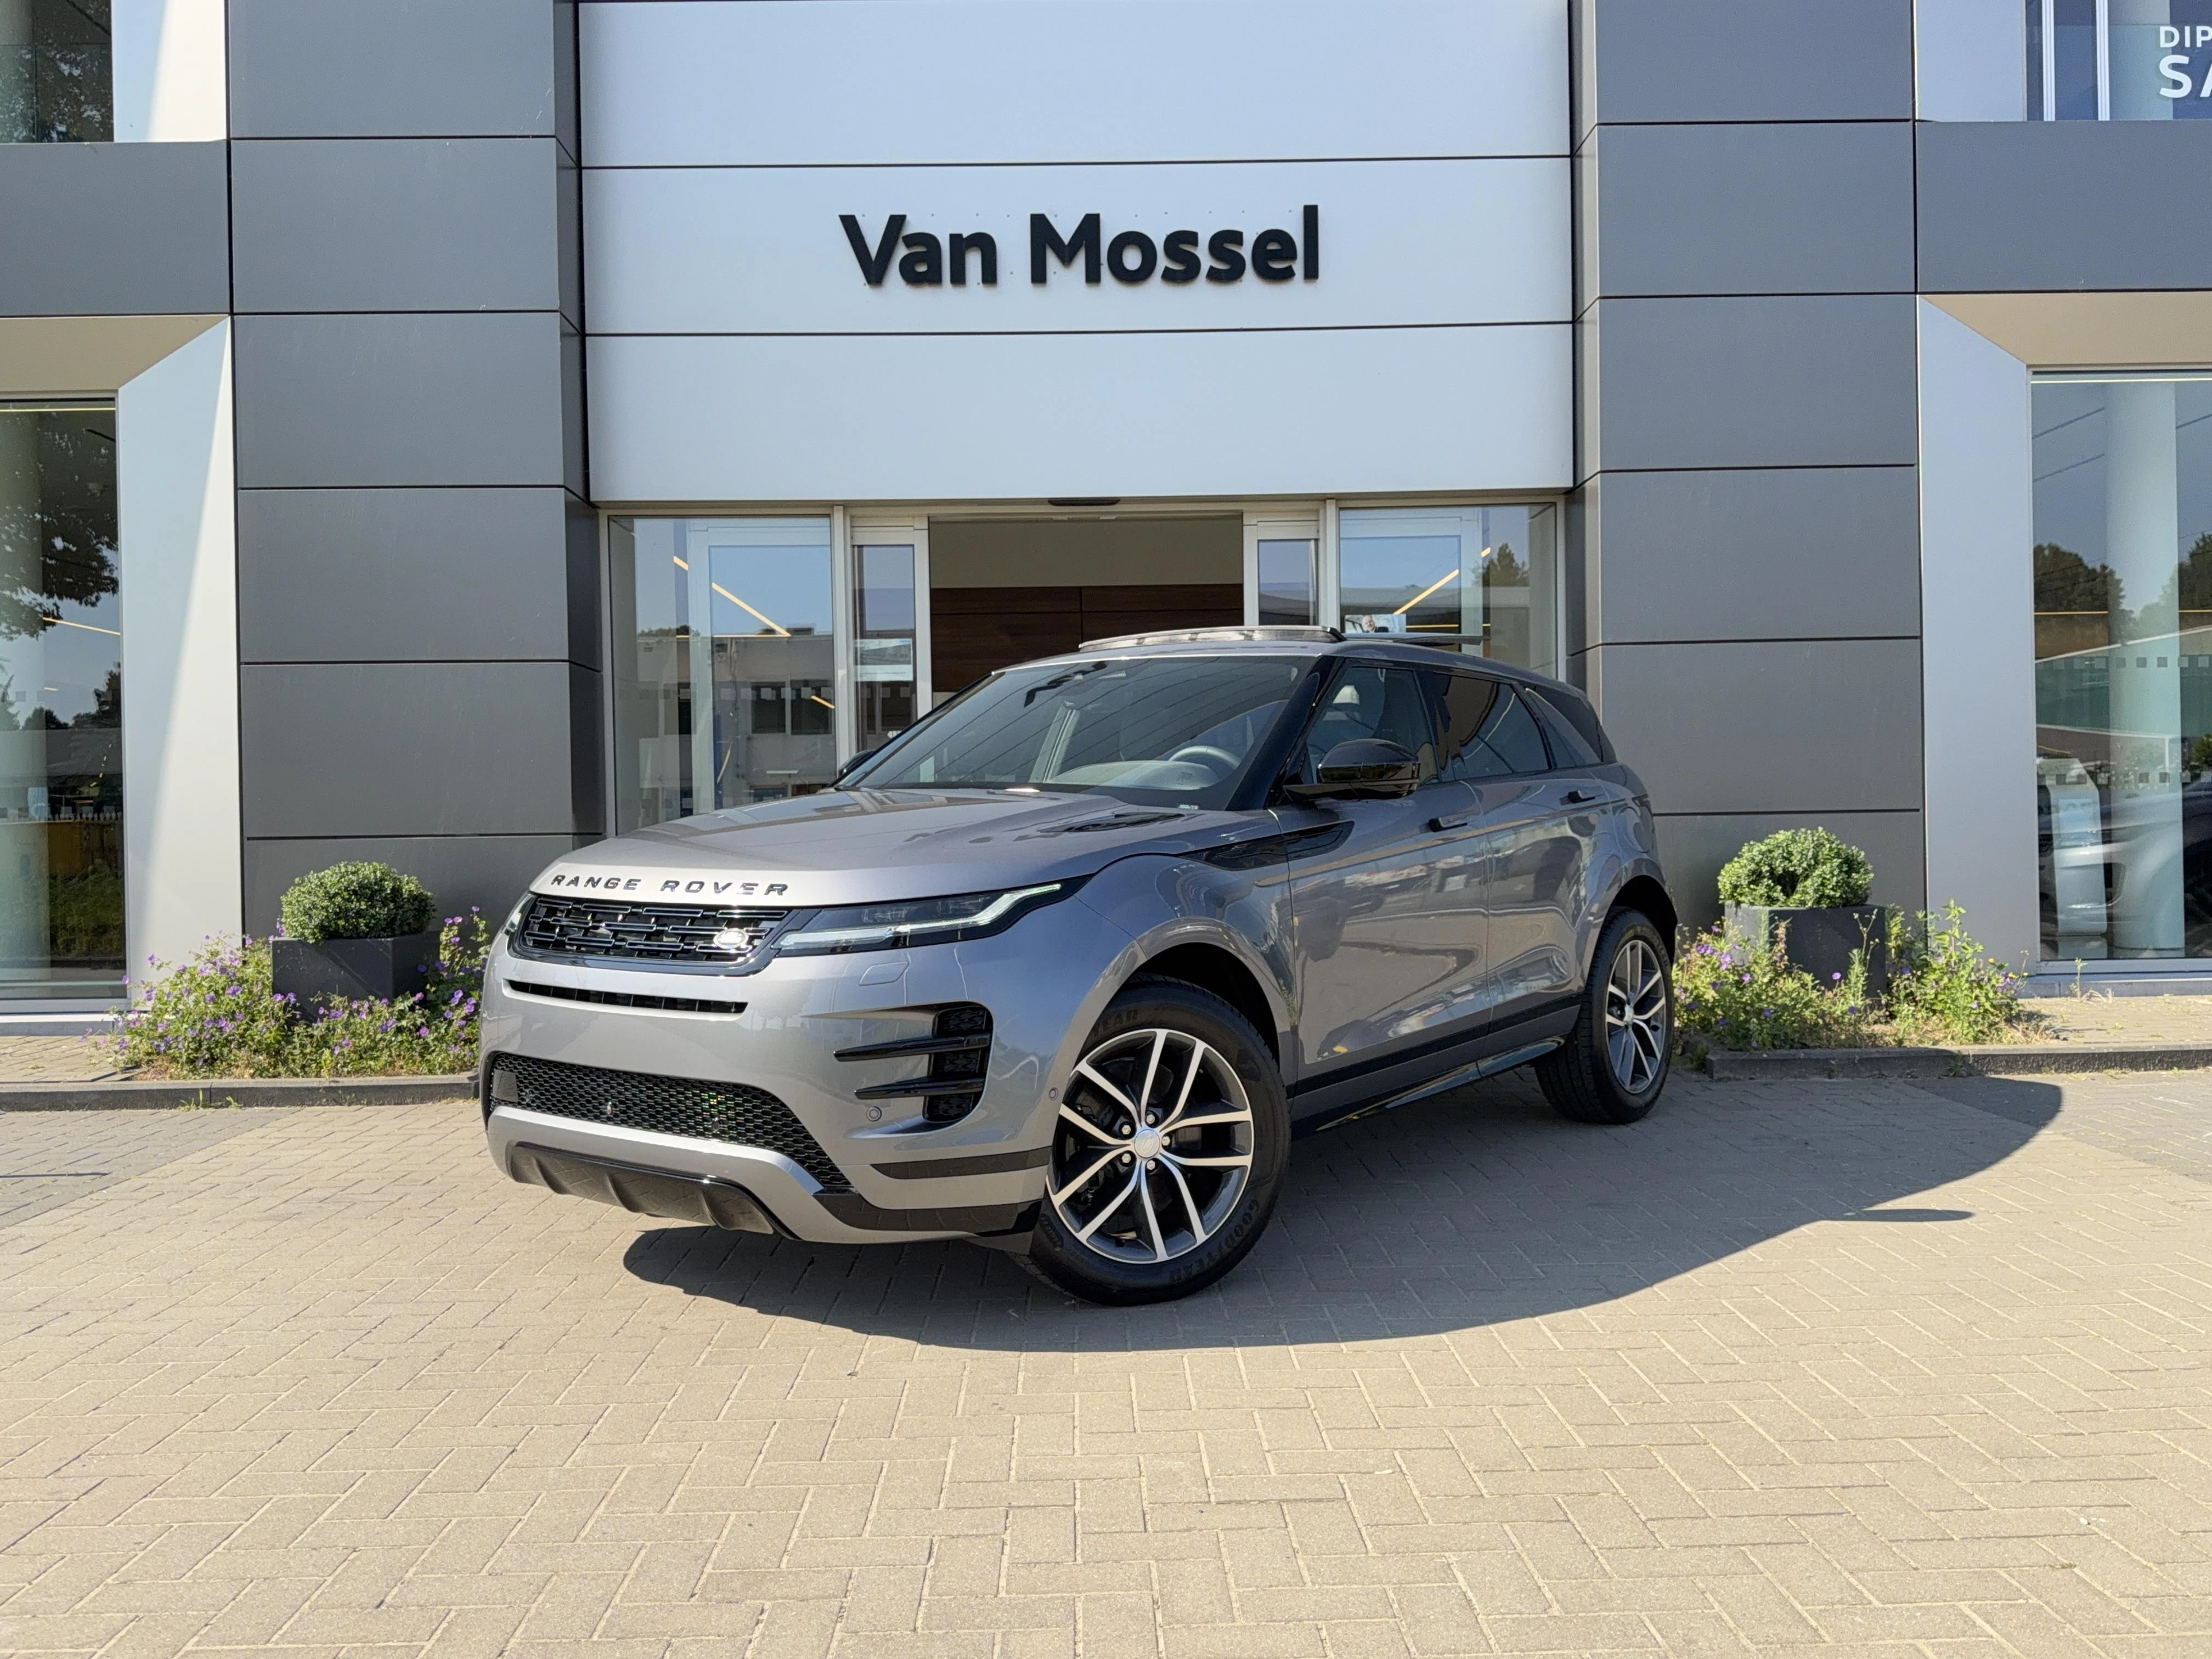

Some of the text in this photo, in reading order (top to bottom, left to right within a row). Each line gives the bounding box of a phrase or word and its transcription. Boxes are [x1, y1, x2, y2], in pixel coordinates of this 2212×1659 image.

[2159, 25, 2212, 48] DIP
[838, 204, 1319, 285] Van Mossel
[551, 874, 788, 896] RANGE ROVER
